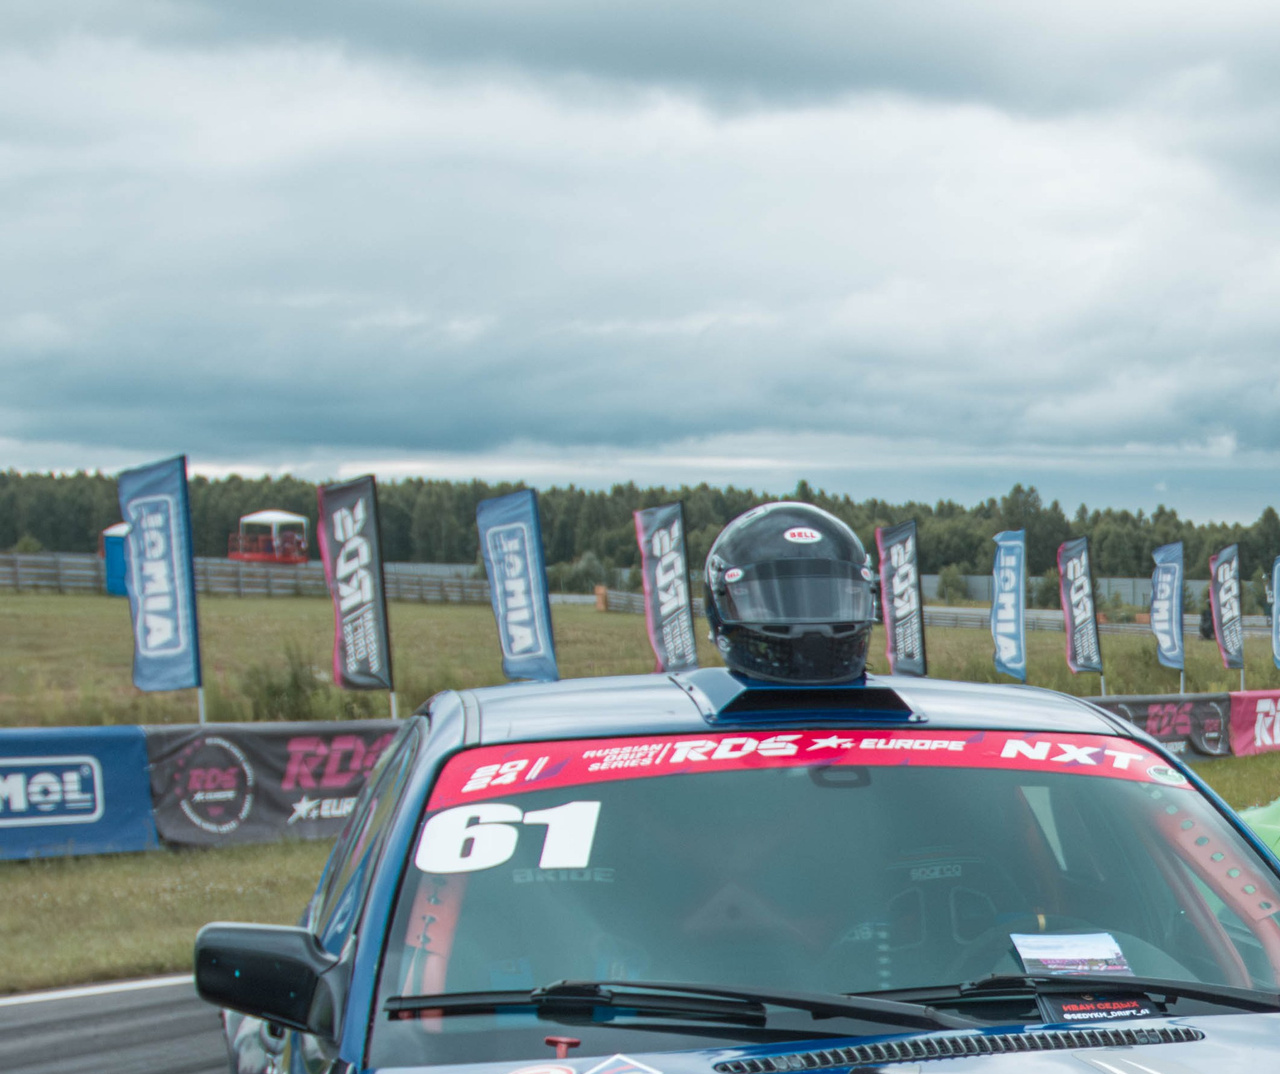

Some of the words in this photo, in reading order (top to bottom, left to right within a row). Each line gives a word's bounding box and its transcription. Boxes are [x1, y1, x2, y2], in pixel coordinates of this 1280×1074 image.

[583, 743, 663, 759] RUSSIAN
[603, 750, 657, 763] DRIFT
[669, 735, 803, 763] RDS
[859, 738, 966, 751] EUROPE
[1000, 739, 1144, 769] NXT
[470, 759, 529, 779] 20
[588, 757, 652, 772] SERIES
[461, 772, 518, 793] 24
[415, 800, 601, 874] 61
[512, 868, 615, 883] BRIDE
[911, 864, 962, 881] sparco
[1062, 1003, 1095, 1012] ИВАН
[1097, 1001, 1139, 1010] СЕДЫХ
